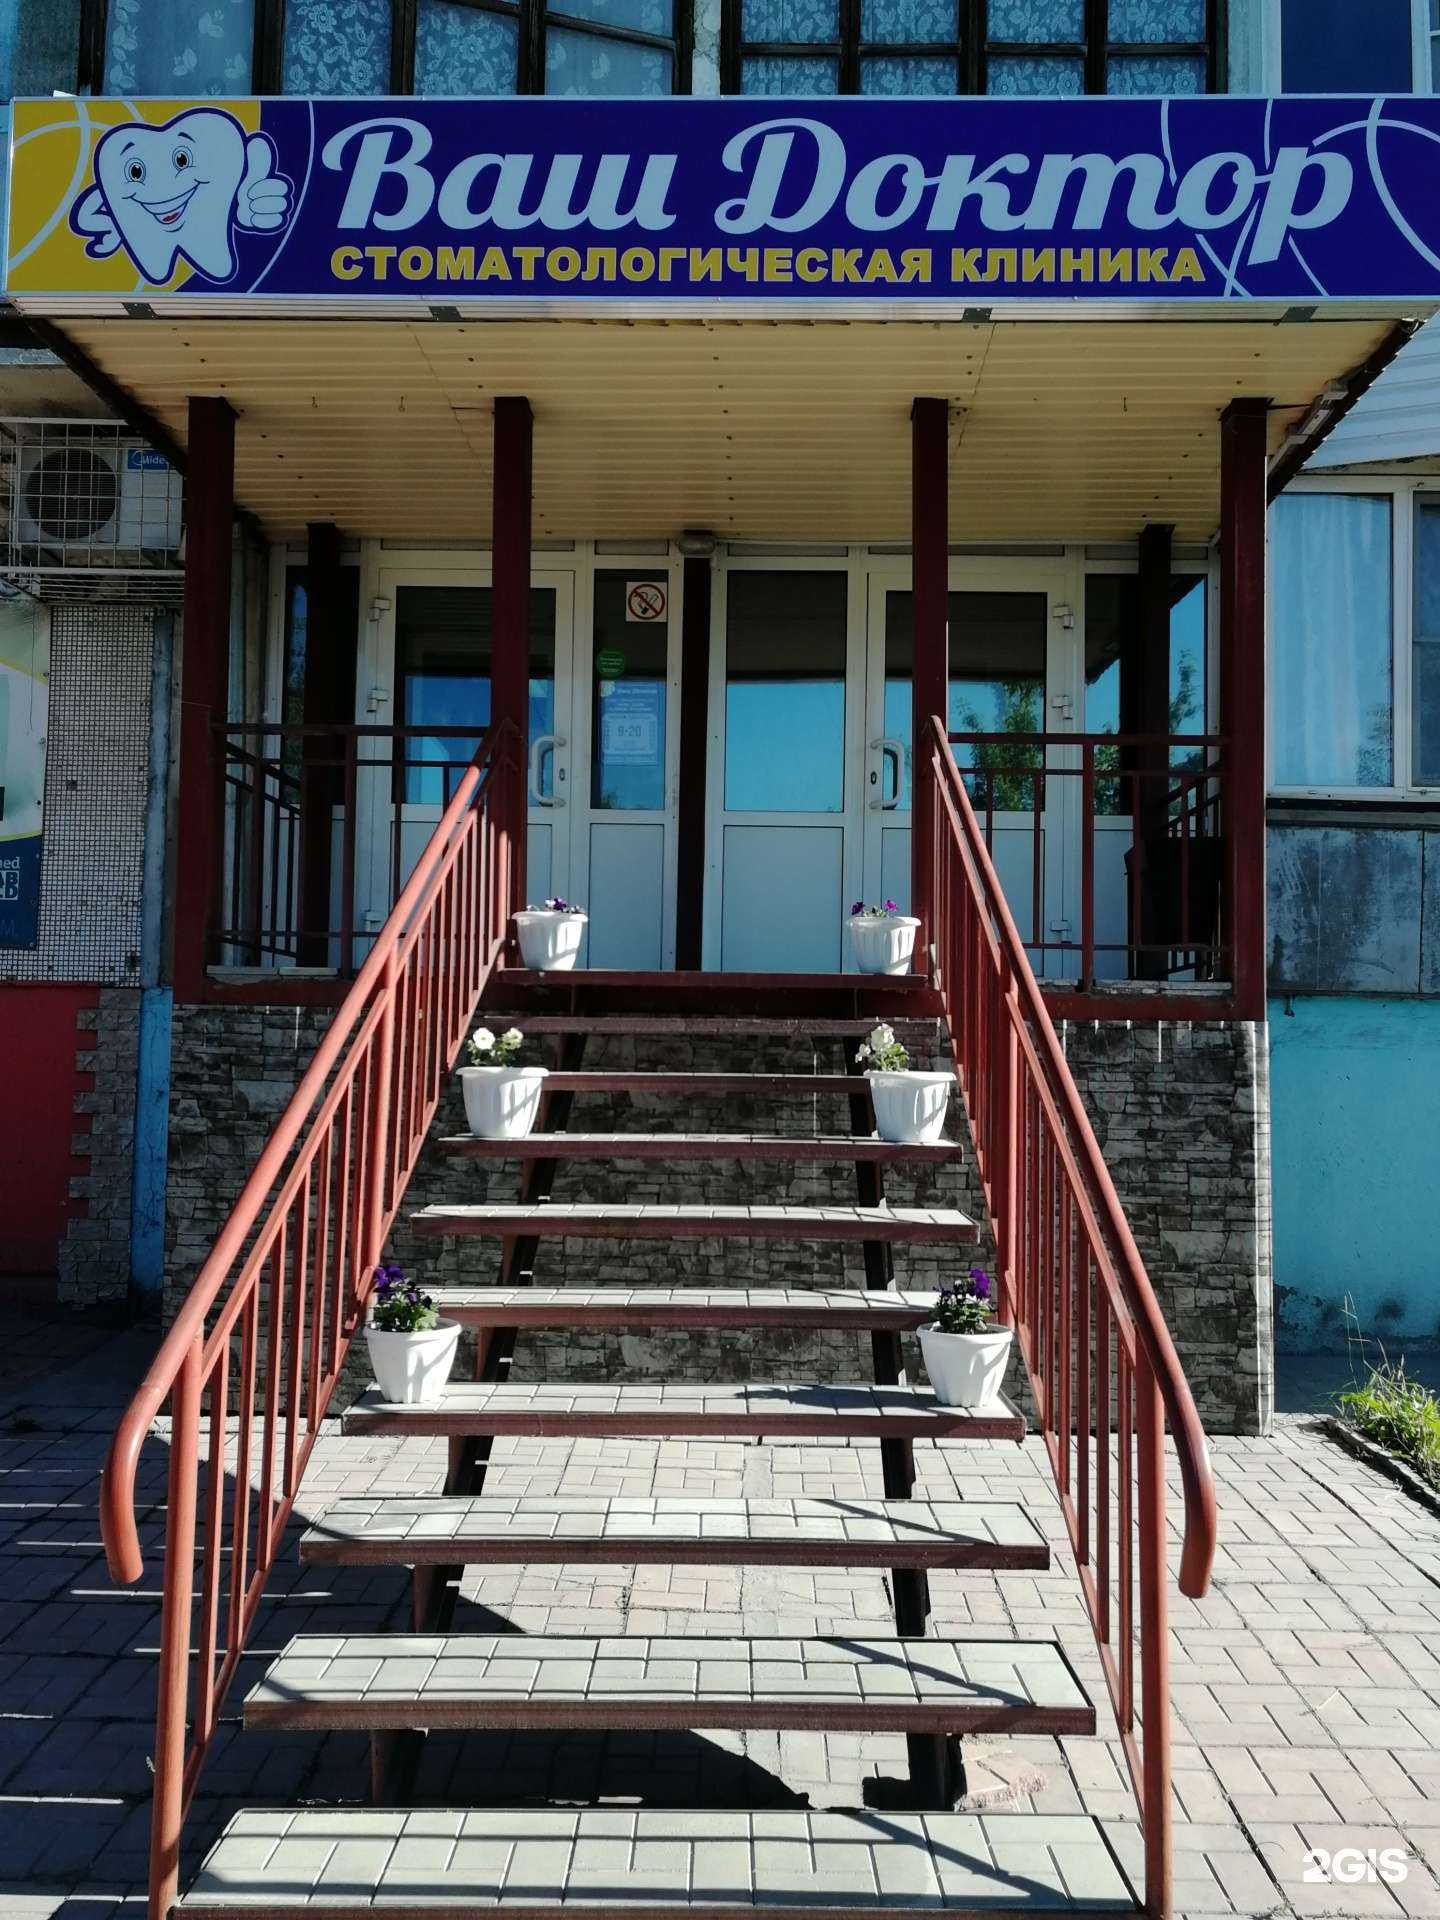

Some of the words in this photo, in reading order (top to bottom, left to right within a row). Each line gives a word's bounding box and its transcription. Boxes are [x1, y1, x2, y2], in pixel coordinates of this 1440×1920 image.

[322, 117, 678, 231] Ваш
[713, 117, 1354, 266] Доктор
[330, 245, 932, 283] СТОМАТОЛОГИЧЕСКАЯ
[951, 246, 1205, 283] КЛИНИКА
